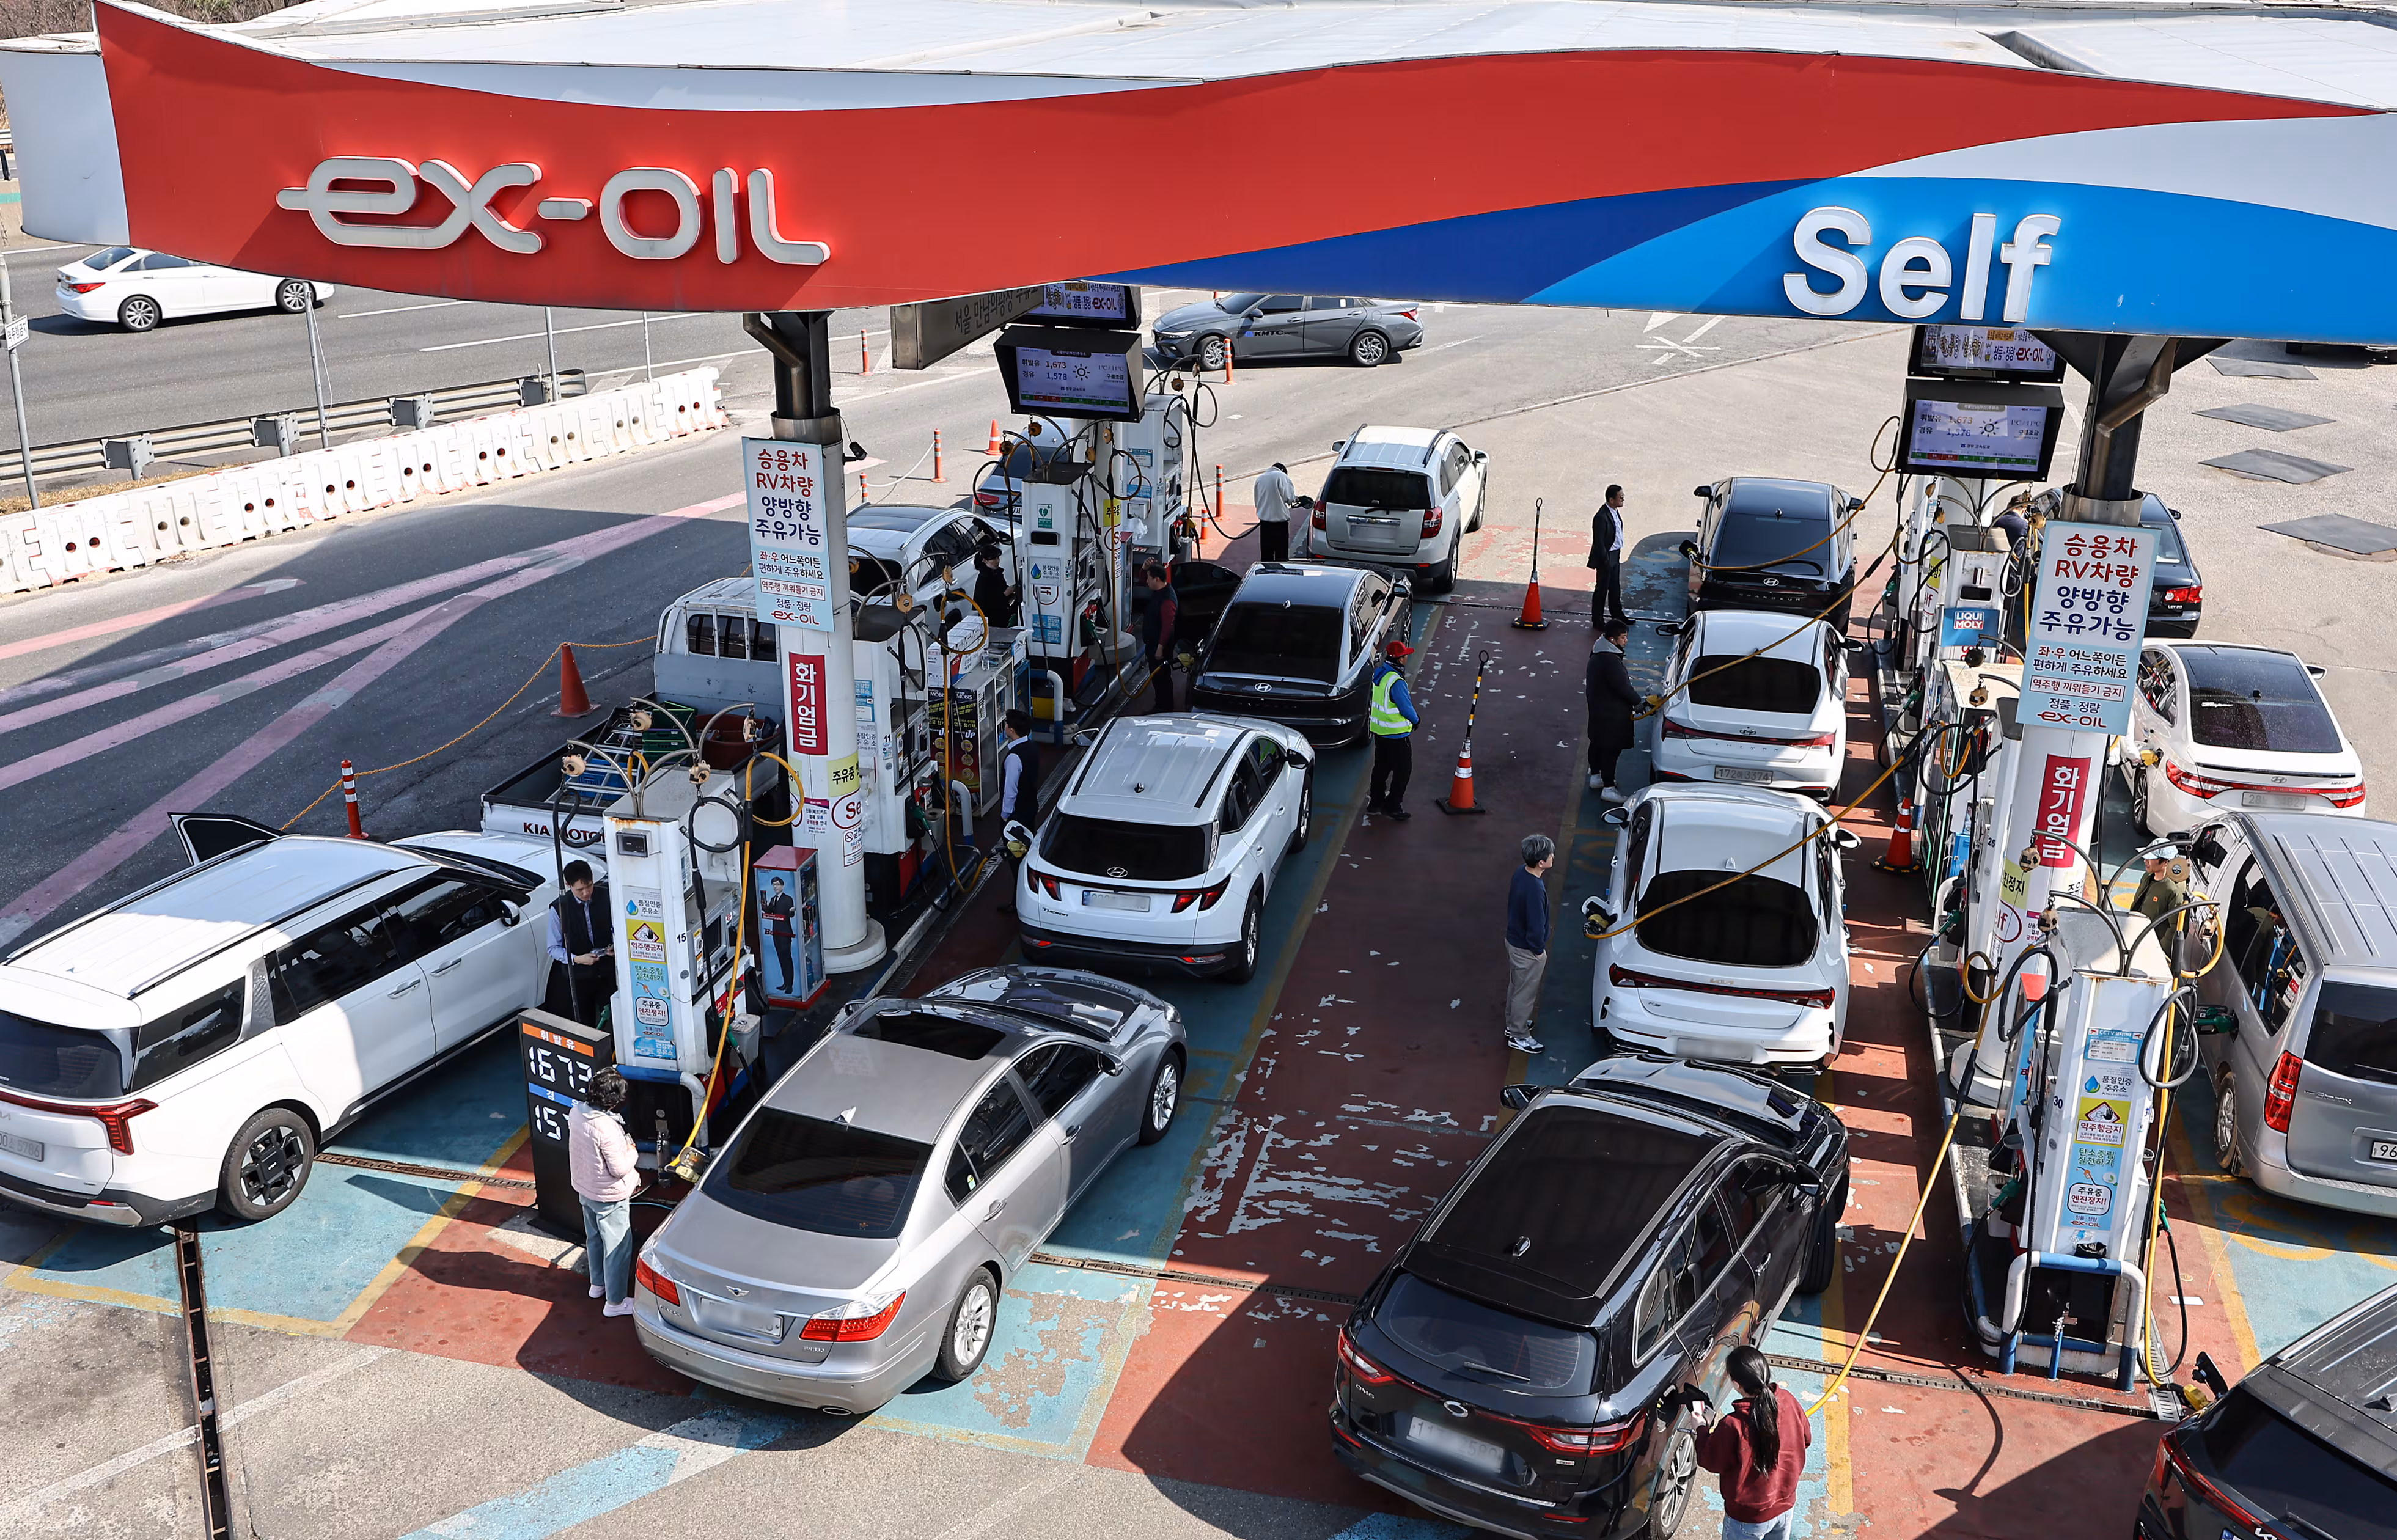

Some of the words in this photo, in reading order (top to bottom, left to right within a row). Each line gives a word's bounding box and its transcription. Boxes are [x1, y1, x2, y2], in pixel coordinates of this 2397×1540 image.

[276, 156, 831, 265] ex-OIL
[1783, 206, 2061, 322] Self
[955, 304, 971, 335] 서울
[1948, 416, 1973, 424] 1,673
[1946, 428, 1971, 437] 1,578
[757, 448, 808, 471] 승용차
[756, 472, 813, 497] RV차량
[761, 496, 812, 521] 양방향
[755, 519, 821, 546] 주유가능
[2064, 533, 2138, 559] 승용차
[780, 554, 821, 568] 어느쪽이든
[758, 563, 782, 576] 편하게
[784, 566, 824, 581] 주유하세요
[2055, 559, 2139, 588] RV차량
[762, 581, 781, 592] 역주행
[782, 583, 809, 595] 끼워들기
[810, 586, 823, 597] 금지
[2057, 585, 2130, 614] 양방향
[771, 610, 820, 626] ex-OIL
[1955, 620, 1983, 629] MOLY
[2039, 610, 2136, 641] 주유가능
[2069, 649, 2127, 666] 어느쪽이든
[2033, 659, 2067, 673] 편하게
[2069, 663, 2127, 680] 주유하세요
[2033, 678, 2060, 691] 역주행
[2063, 681, 2100, 695] 끼워들기
[2102, 686, 2121, 697] 금지
[795, 662, 817, 748] 화기엄금
[2037, 711, 2107, 728] ex-OIL
[884, 734, 891, 743] 11
[965, 730, 976, 738] UP
[832, 765, 854, 785] 주유중
[1745, 771, 1769, 782] 3374
[523, 822, 551, 837] KIA
[1988, 837, 1995, 848] 26
[638, 900, 661, 909] 품질인증
[642, 907, 659, 915] 주유소
[676, 933, 687, 945] 15
[631, 942, 663, 952] 역주행금지
[638, 1007, 666, 1017] 엔진정지!
[642, 1000, 661, 1010] 주유중
[2102, 1075, 2132, 1086] 품질인증
[2104, 1084, 2127, 1093] 주유소
[2054, 1096, 2063, 1109] 30
[2080, 1122, 2121, 1134] 역주행금지
[18, 1140, 40, 1157] 5786
[2079, 1148, 2115, 1160] 탄소중립
[2078, 1156, 2113, 1167] 실천하기
[2078, 1186, 2102, 1197] 주유중
[2071, 1195, 2107, 1205] 엔진정지!
